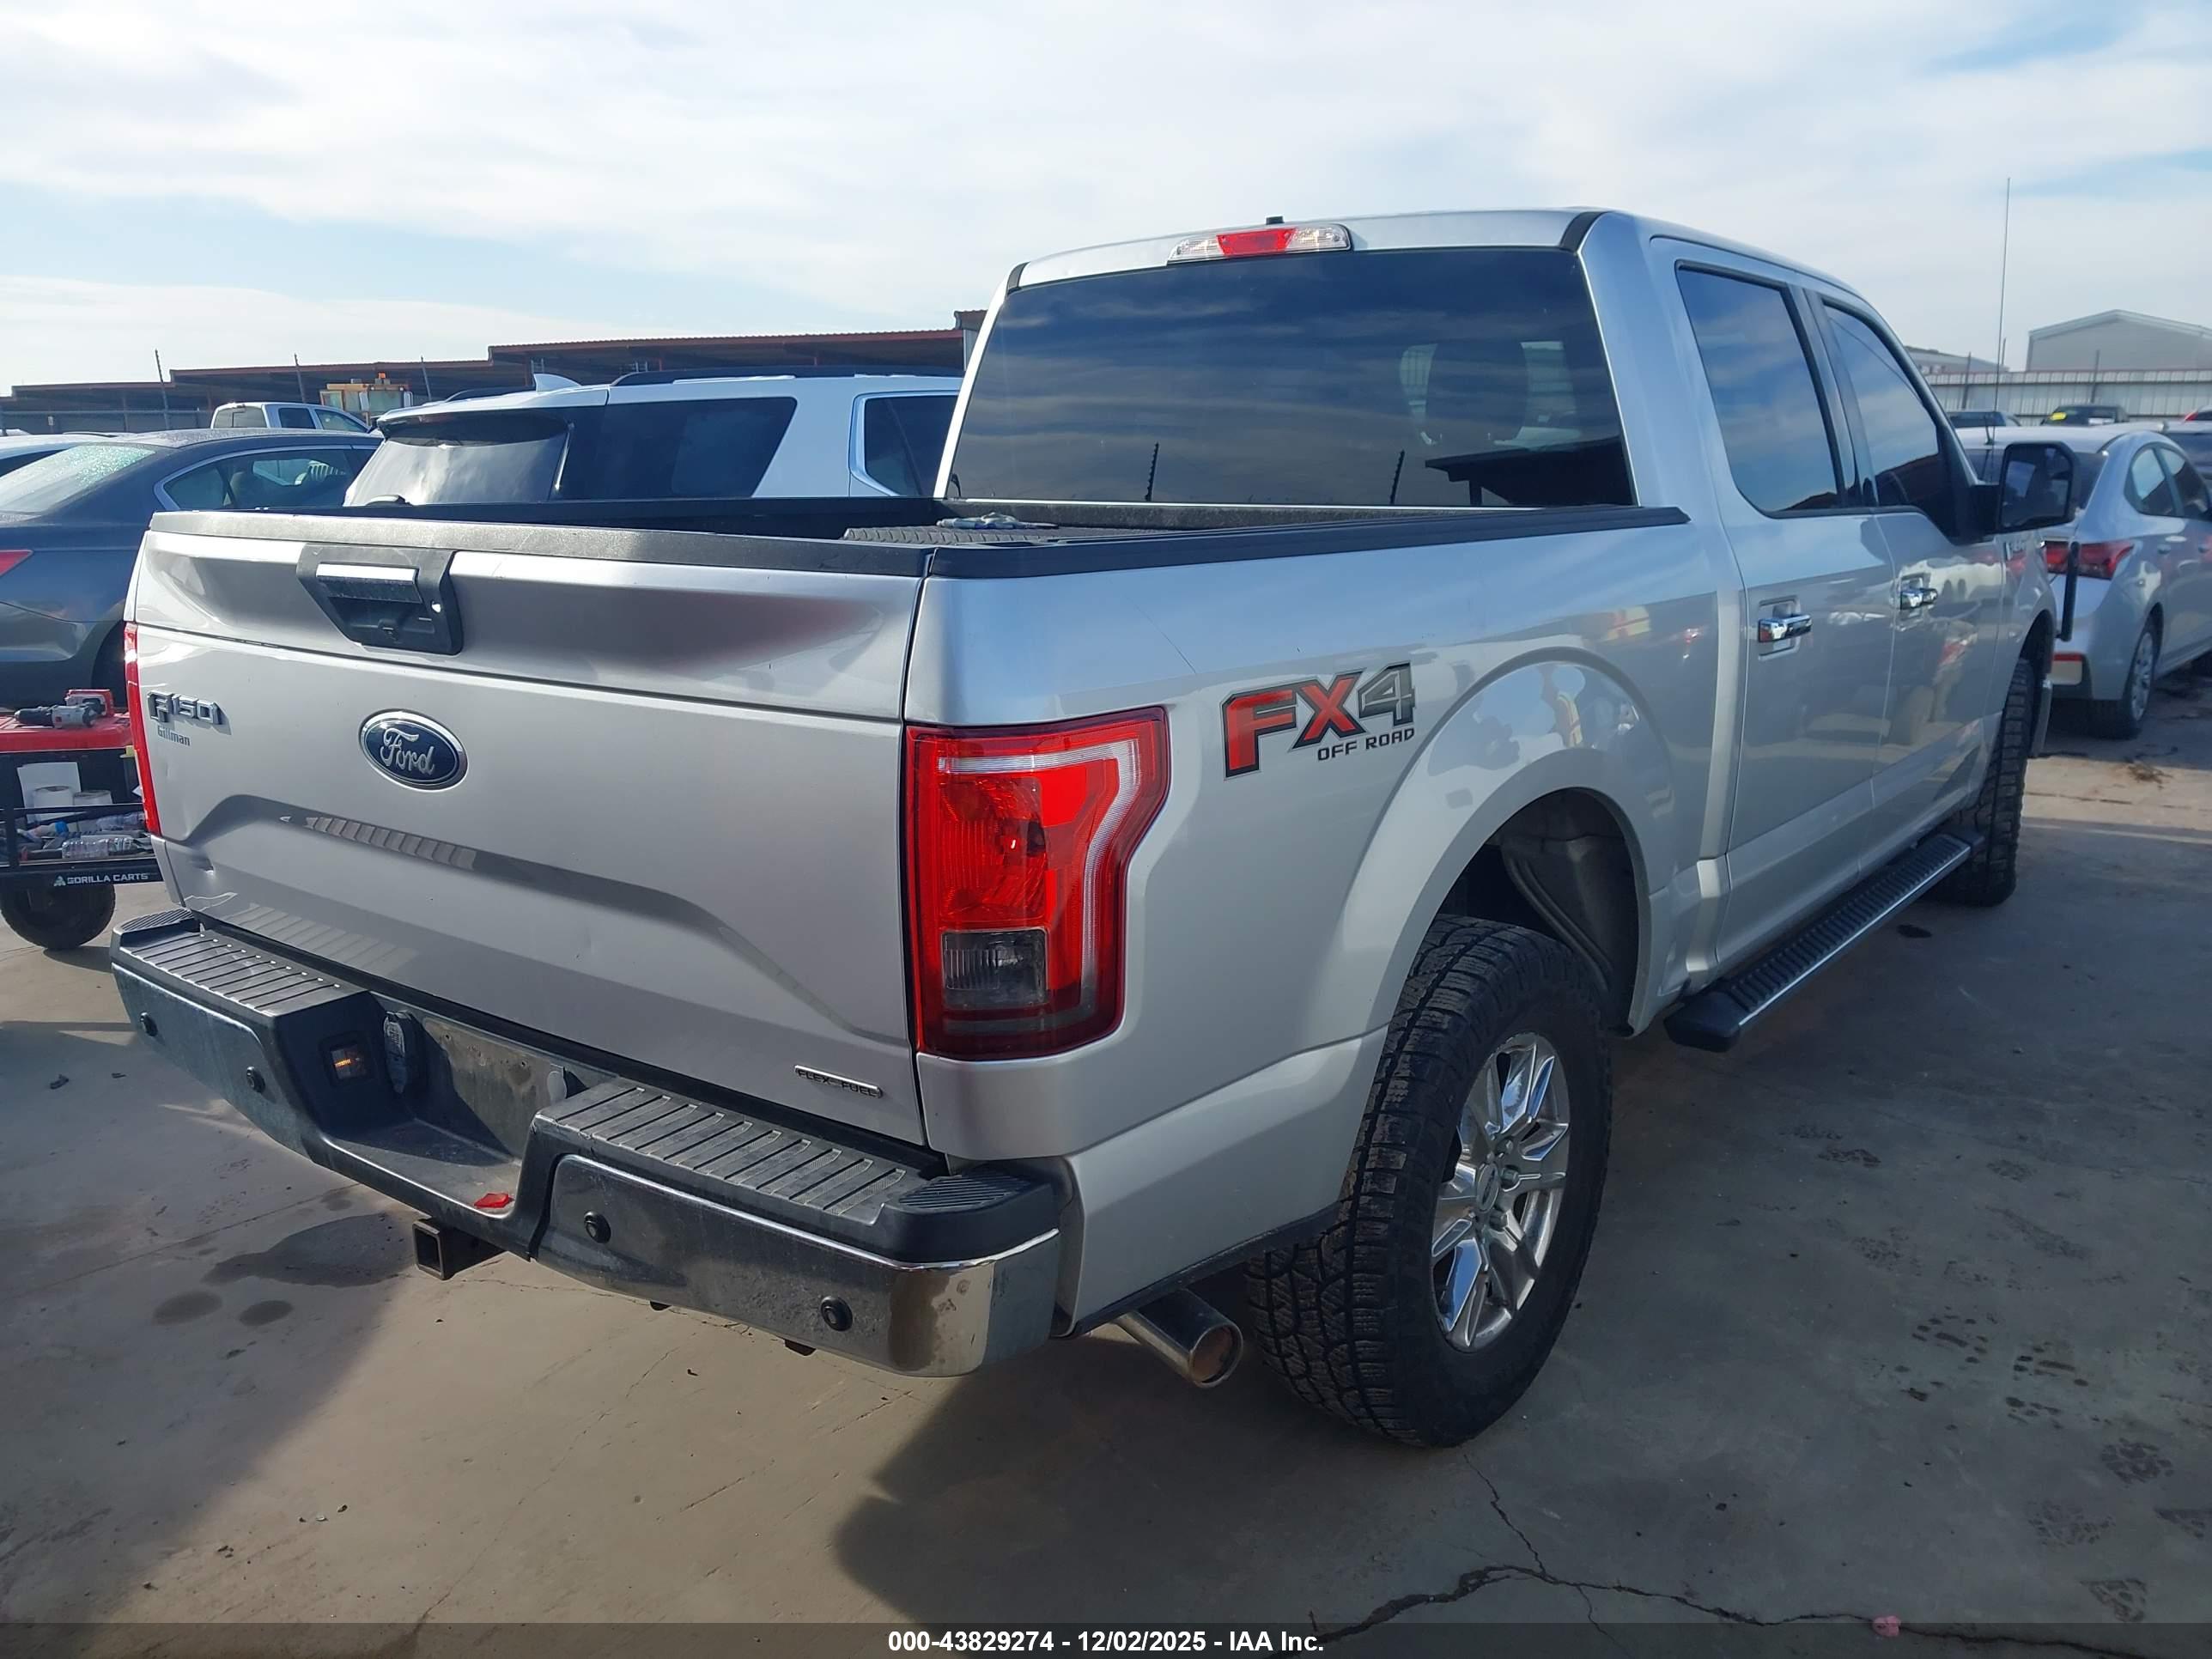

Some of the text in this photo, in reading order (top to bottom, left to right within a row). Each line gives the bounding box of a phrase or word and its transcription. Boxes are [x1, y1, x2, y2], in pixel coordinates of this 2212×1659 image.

[157, 725, 191, 746] Gillman
[1221, 661, 1415, 779] FX4
[380, 727, 435, 775] Ford
[1317, 727, 1415, 762] OFF ROAD
[66, 872, 149, 885] GORILLA CARTS
